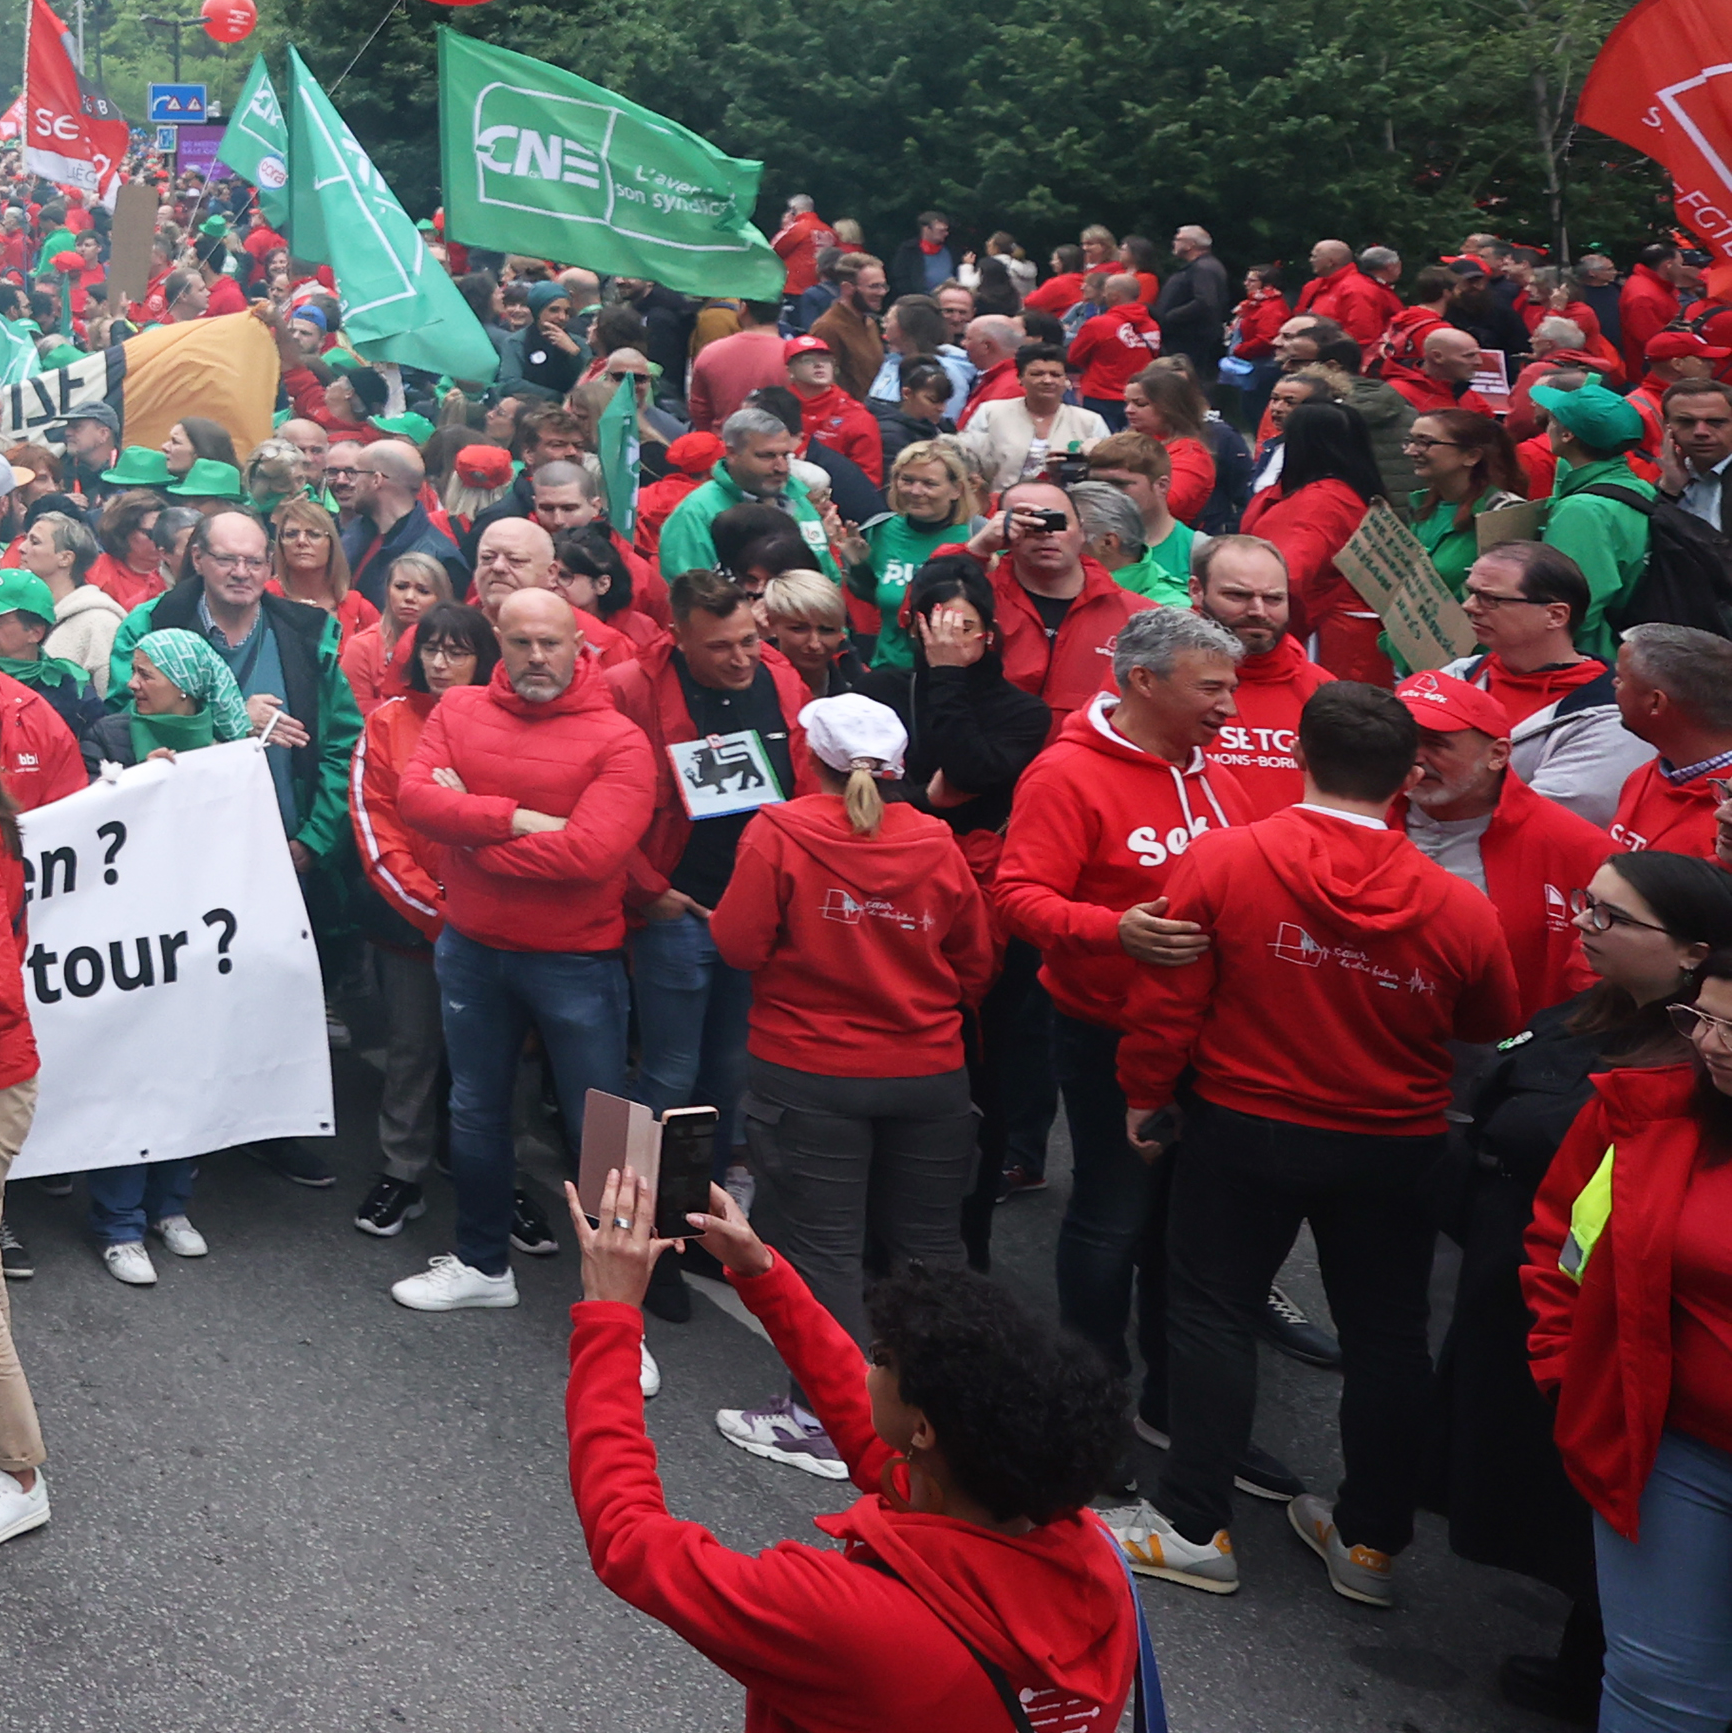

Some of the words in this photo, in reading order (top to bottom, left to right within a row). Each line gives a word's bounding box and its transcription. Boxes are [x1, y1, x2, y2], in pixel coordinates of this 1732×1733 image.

[475, 125, 600, 189] CNE
[614, 183, 646, 203] son
[1219, 725, 1295, 753] SETC
[96, 820, 127, 885] ?
[27, 928, 187, 1005] tour
[203, 907, 238, 975] ?
